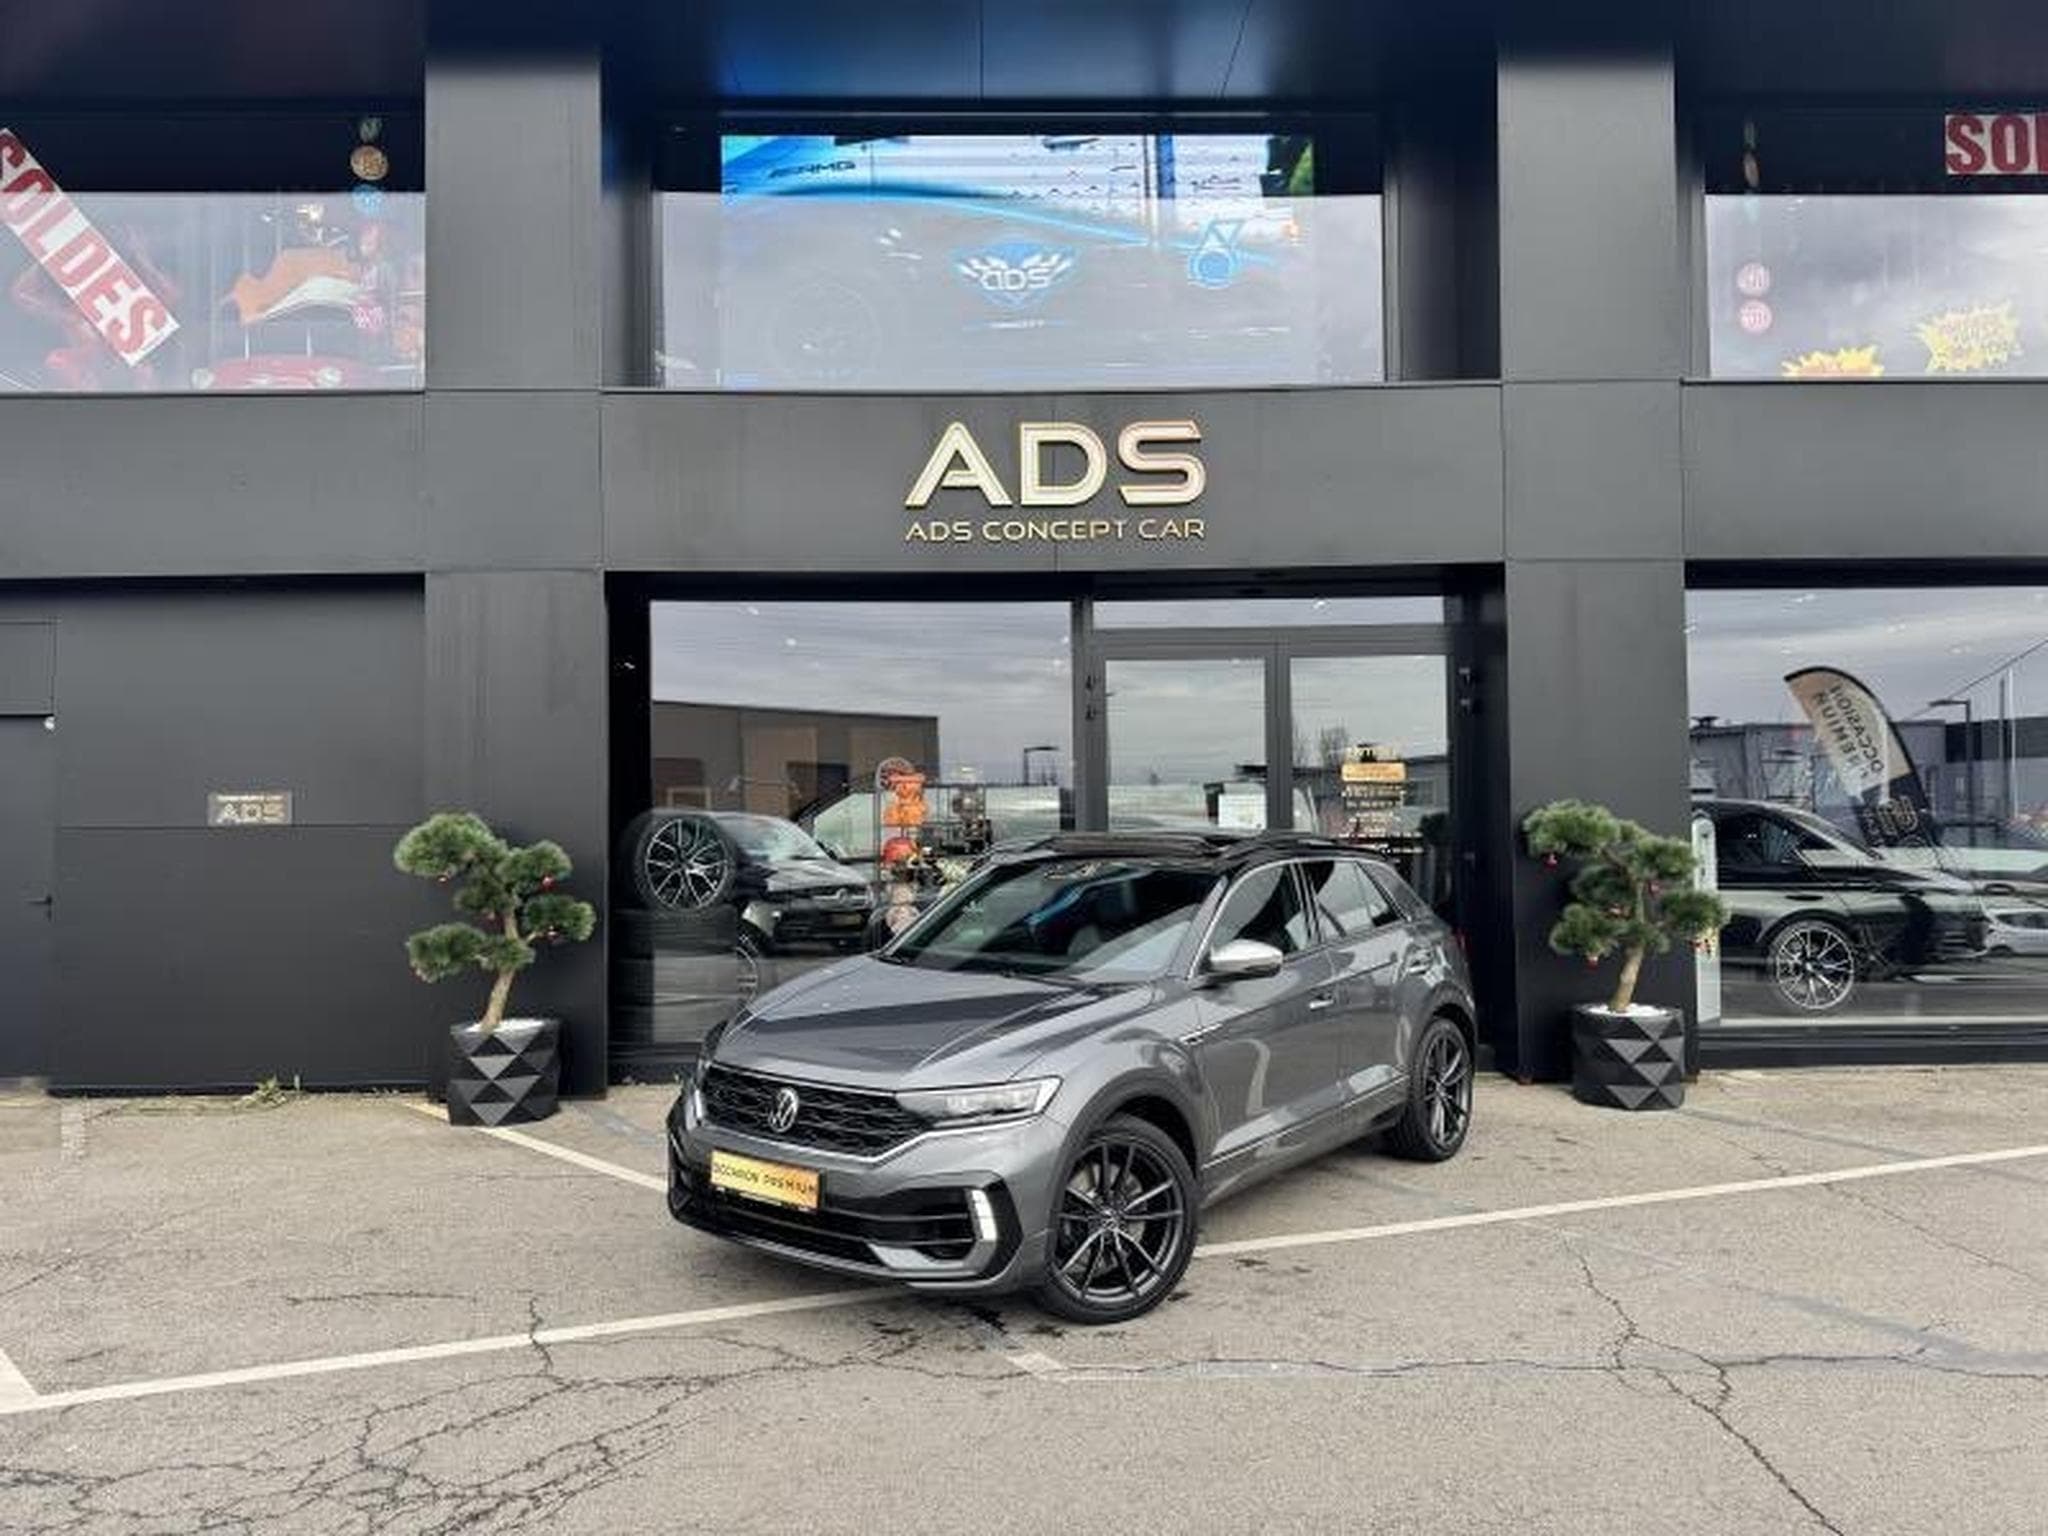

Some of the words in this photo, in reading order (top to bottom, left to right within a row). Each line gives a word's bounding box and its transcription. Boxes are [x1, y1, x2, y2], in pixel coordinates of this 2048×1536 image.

[904, 420, 1206, 506] ADS
[905, 521, 973, 541] ADS
[982, 520, 1126, 541] CONCEPT
[1138, 518, 1206, 540] CAR
